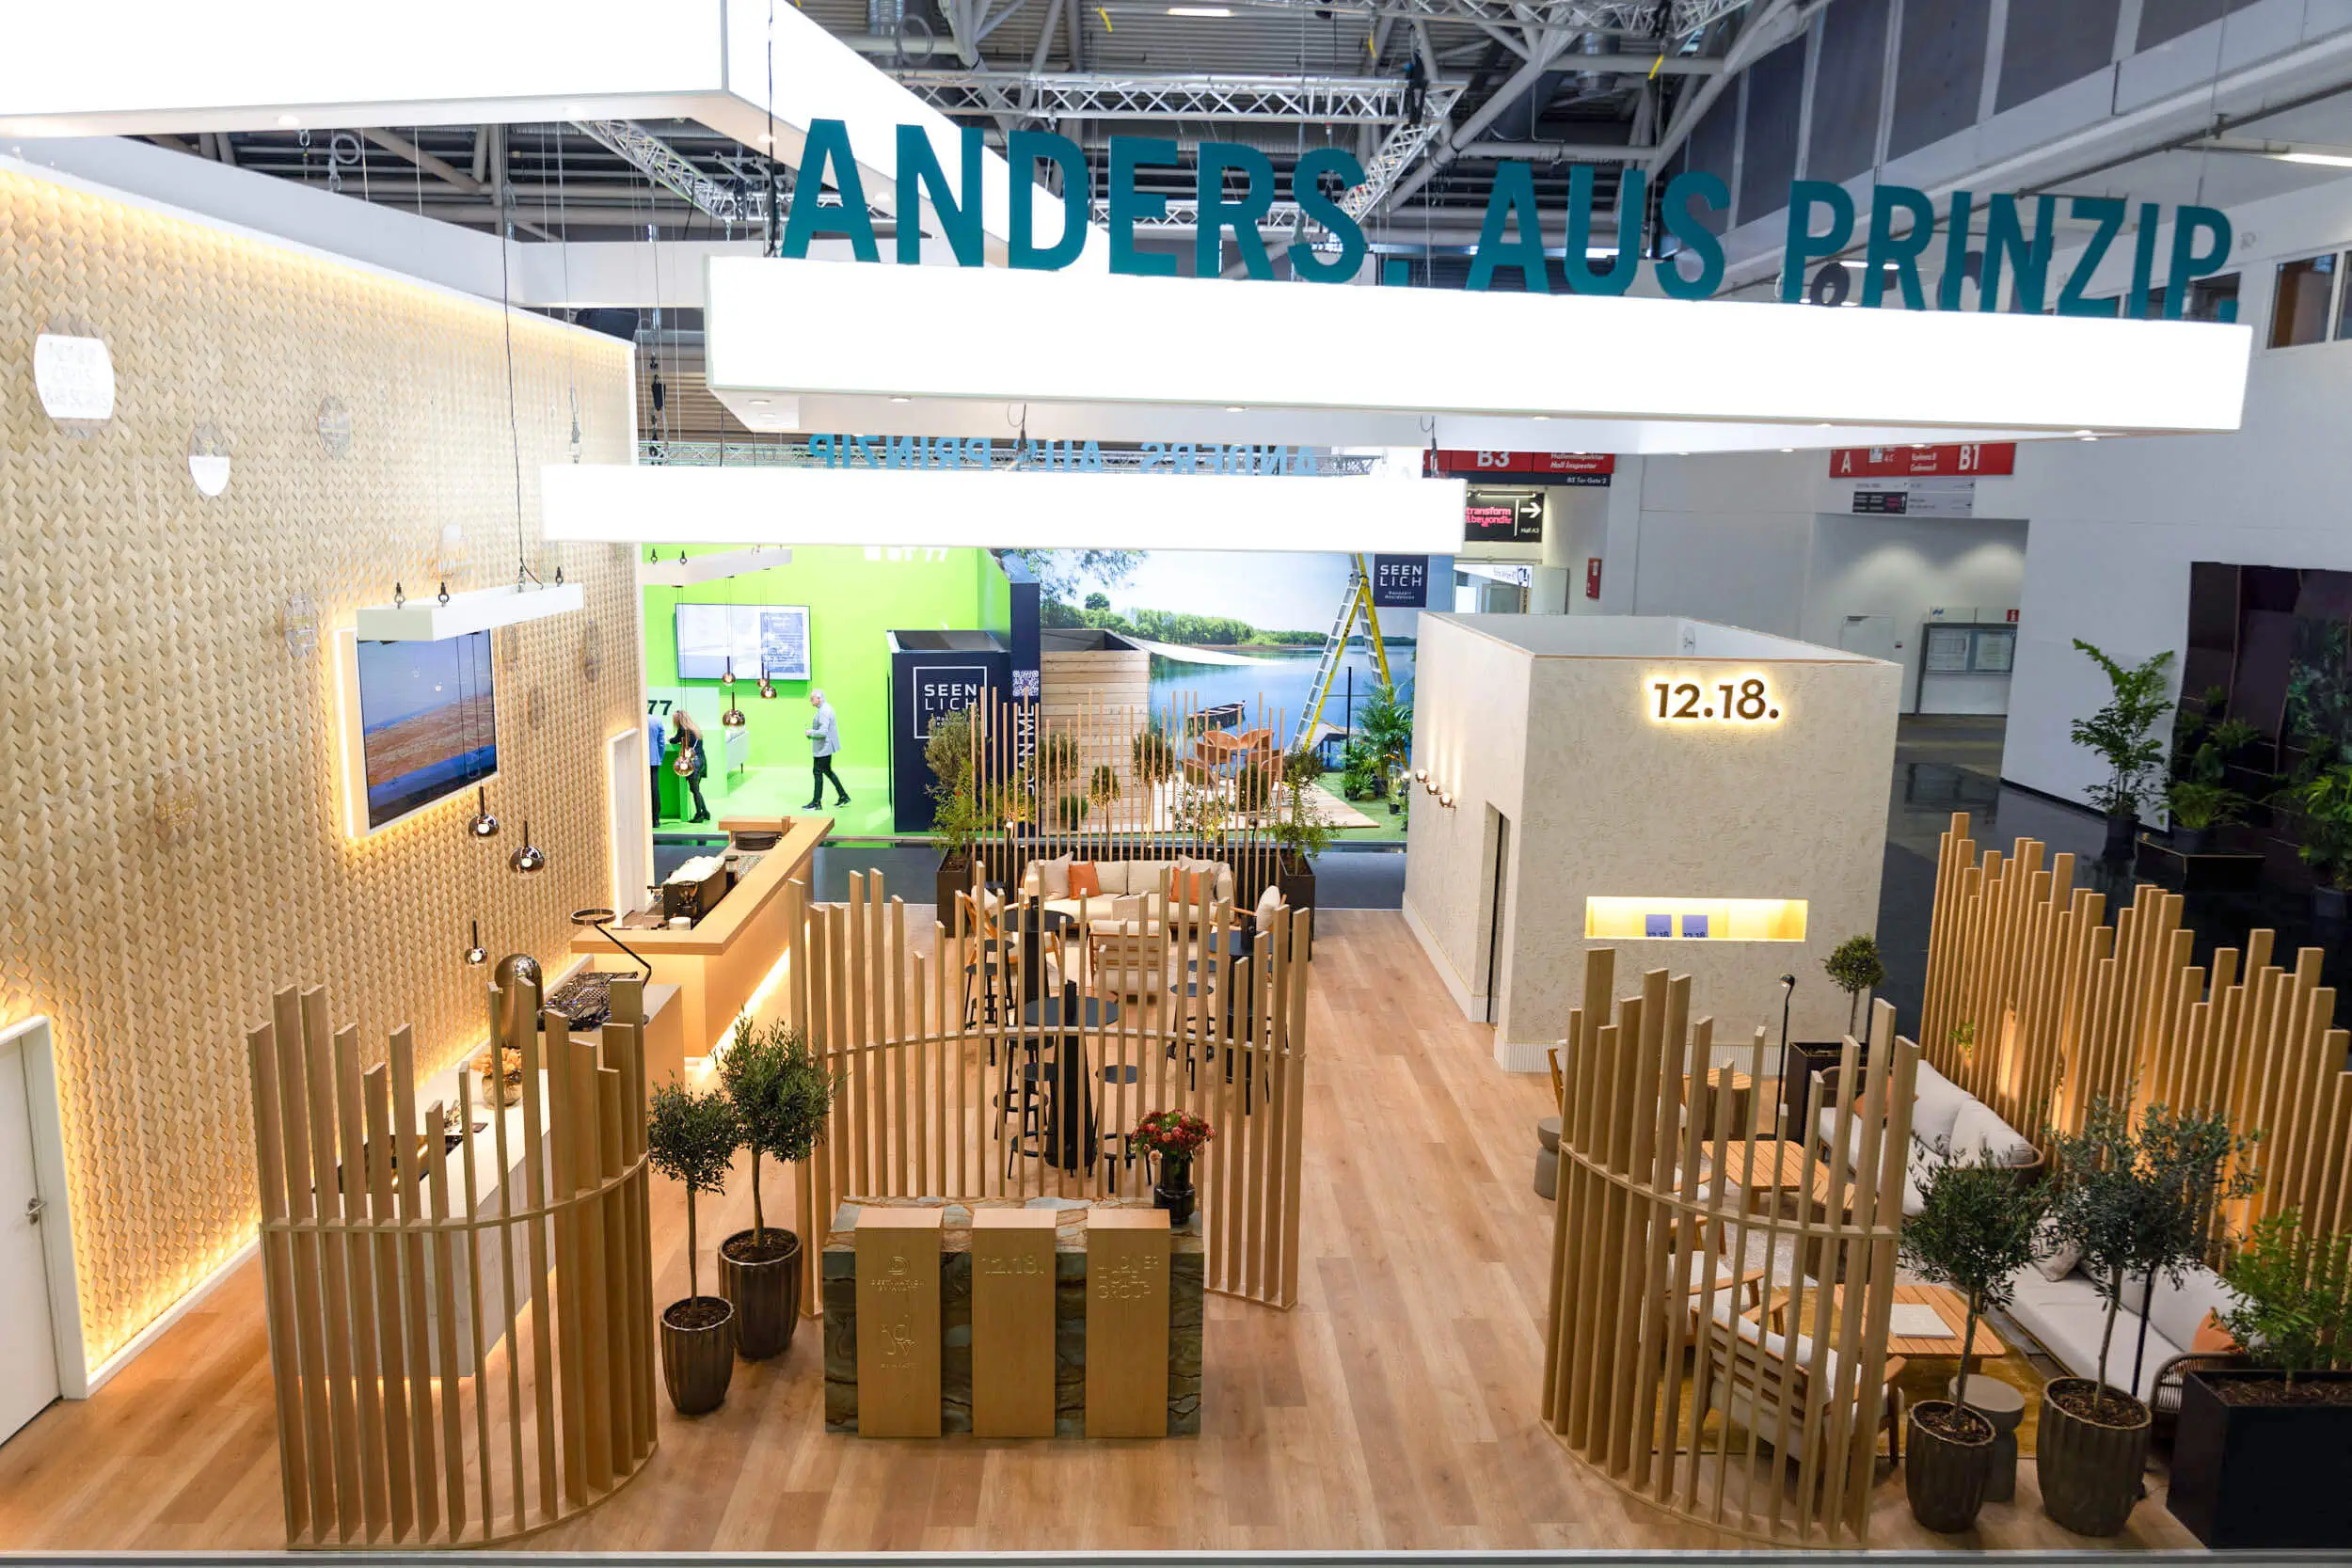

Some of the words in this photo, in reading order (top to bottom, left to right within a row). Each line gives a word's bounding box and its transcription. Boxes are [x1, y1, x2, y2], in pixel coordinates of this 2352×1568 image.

[781, 119, 1408, 287] ANDERS.
[1465, 161, 1729, 300] AUS
[1781, 181, 2238, 323] PRINZIP.
[1477, 451, 1510, 467] B3
[1840, 451, 1851, 473] A
[1959, 444, 1980, 470] B1
[1565, 461, 1597, 469] Inspector
[1466, 506, 1512, 515] transform
[1380, 564, 1422, 576] SEEN
[1380, 576, 1422, 587] LICH
[924, 684, 977, 696] SEEN
[925, 698, 977, 710] LICH
[1654, 679, 1779, 720] 12.18.
